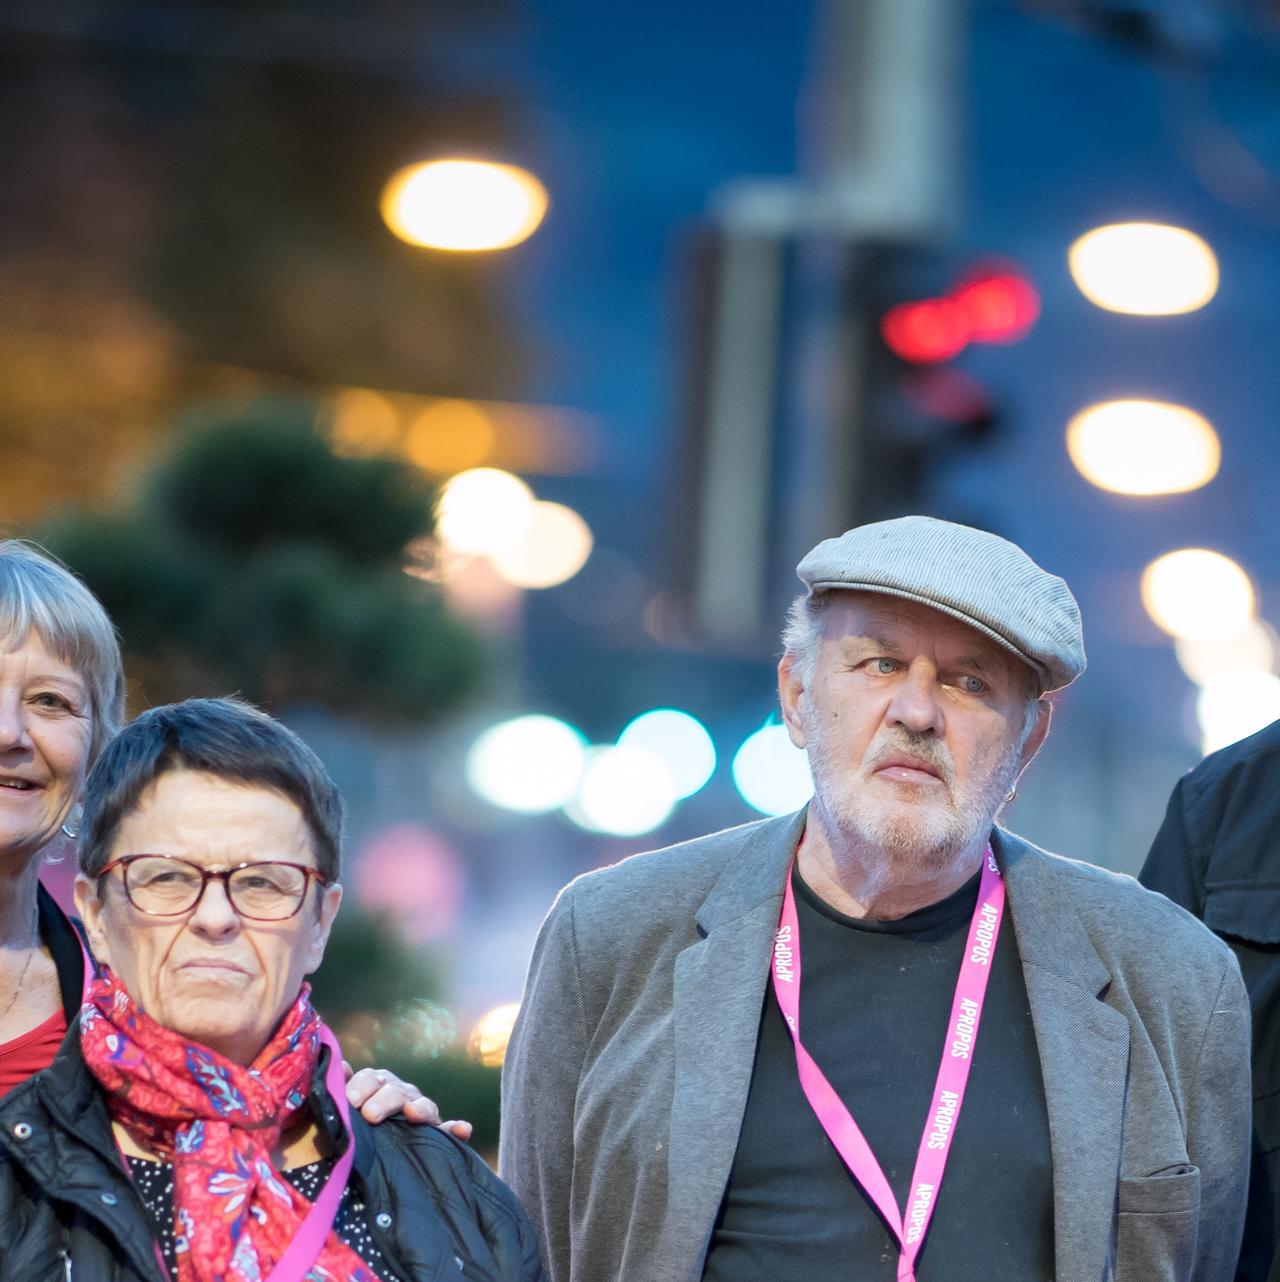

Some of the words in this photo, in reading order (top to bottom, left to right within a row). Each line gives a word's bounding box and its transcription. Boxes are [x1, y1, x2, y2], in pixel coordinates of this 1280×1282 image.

[775, 925, 793, 983] APROPOS
[971, 903, 998, 966] APROPOS
[951, 997, 978, 1060] APROPOS
[928, 1090, 959, 1150] APROPOS
[907, 1183, 934, 1244] APROPOS
